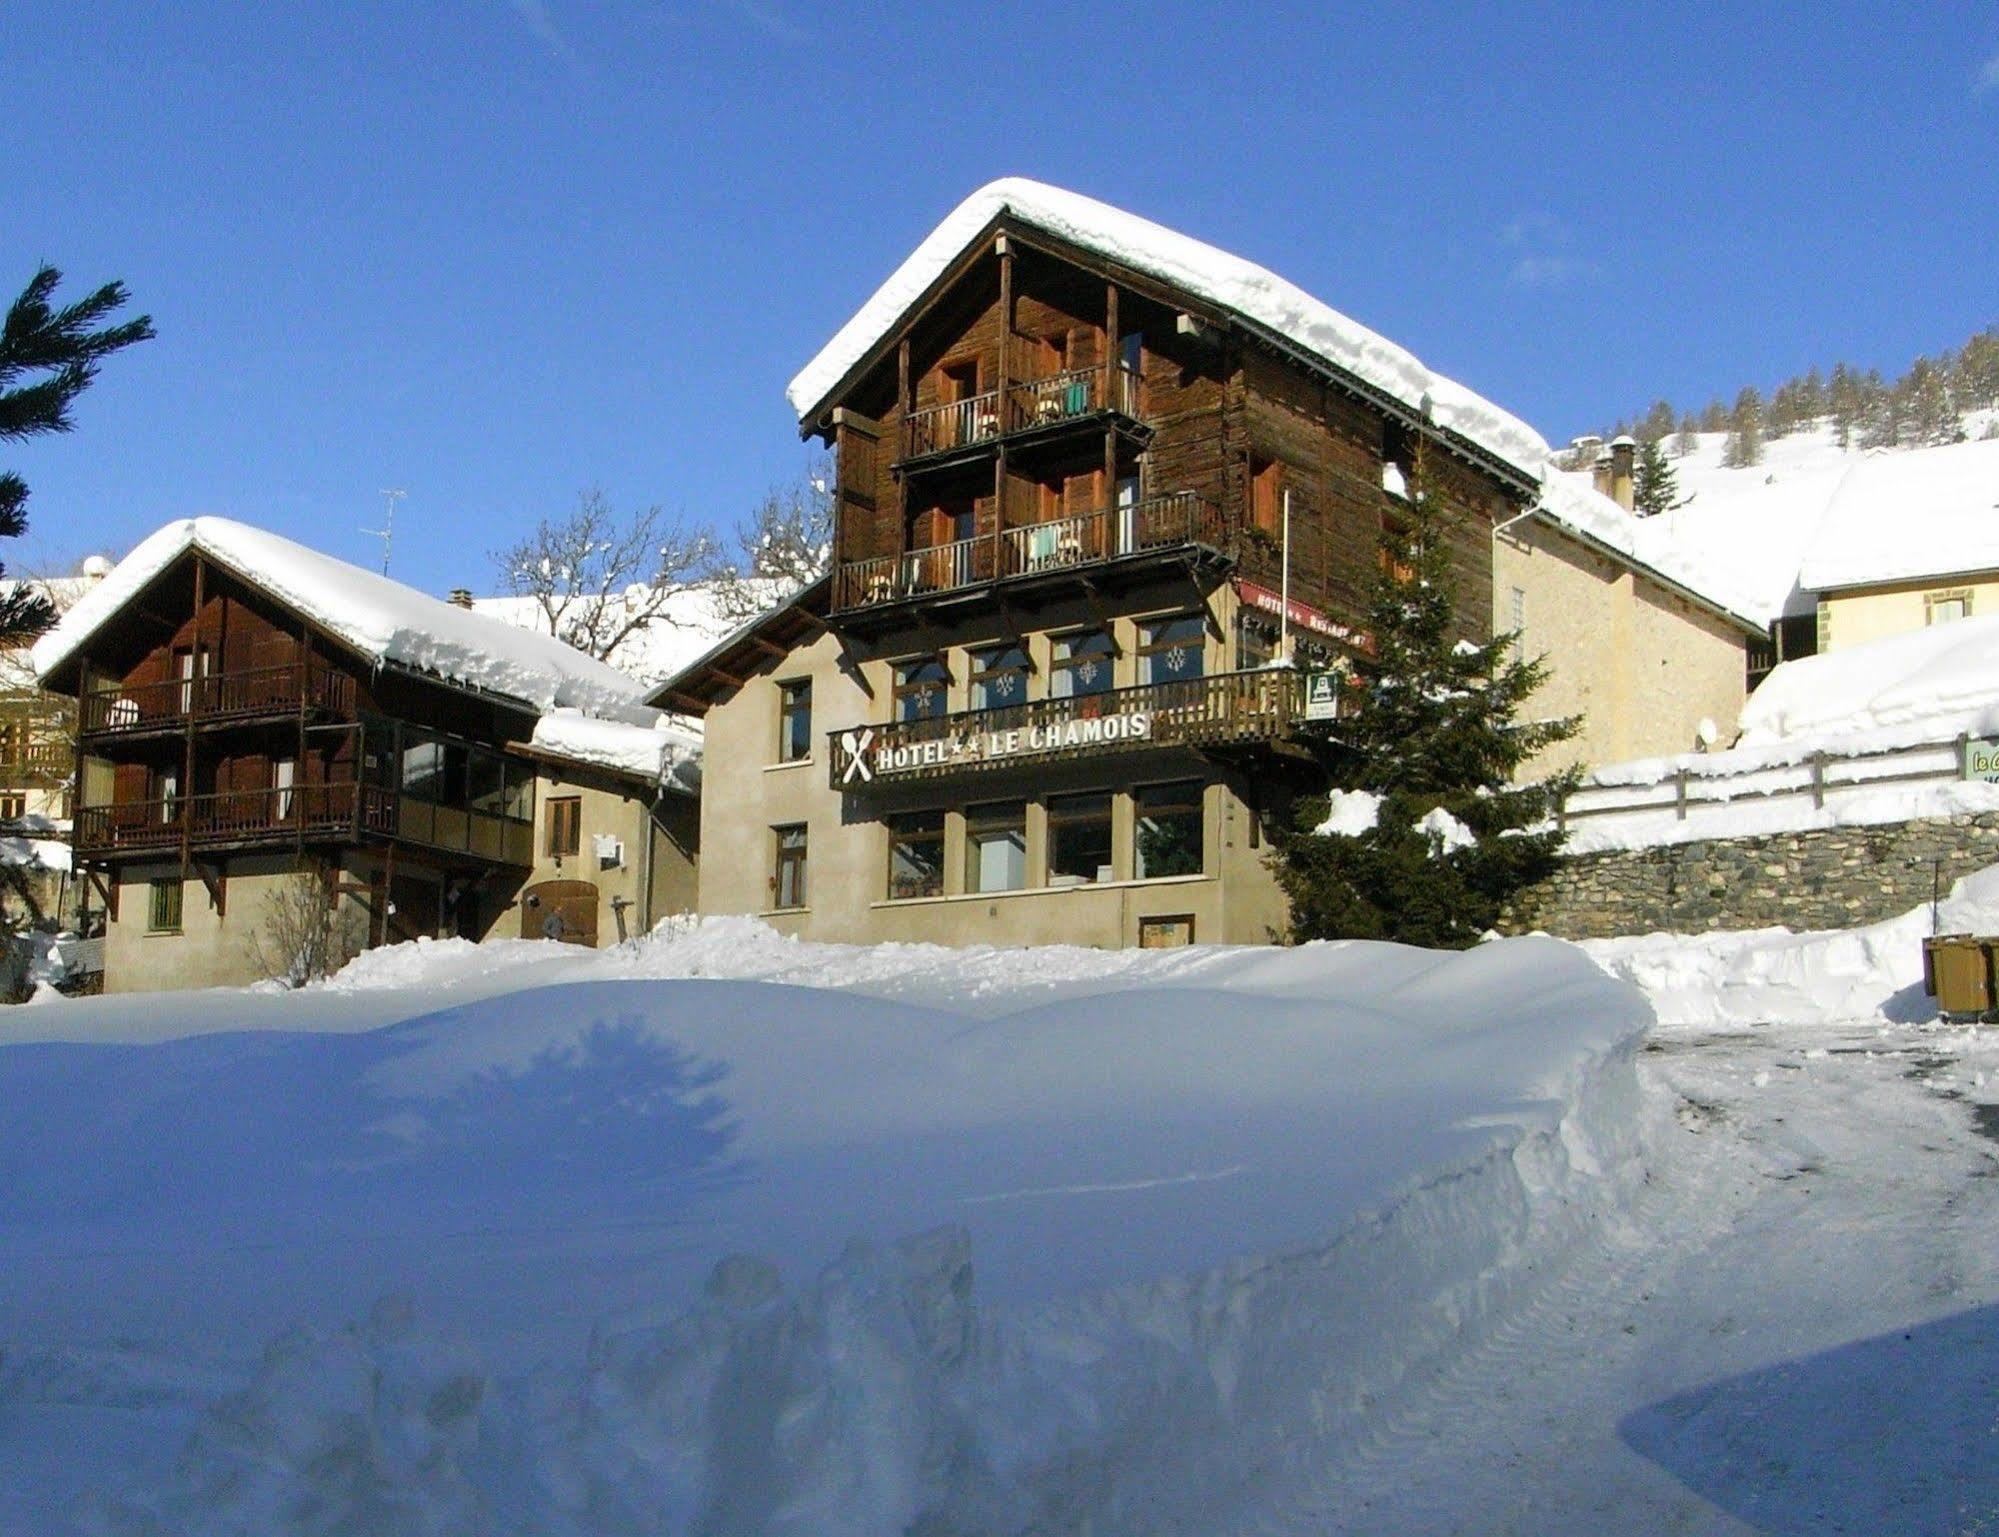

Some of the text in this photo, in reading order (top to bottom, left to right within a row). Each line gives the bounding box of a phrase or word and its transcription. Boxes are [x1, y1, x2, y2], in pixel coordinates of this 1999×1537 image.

[879, 713, 1146, 770] HOTEL LE CHAMOIS
